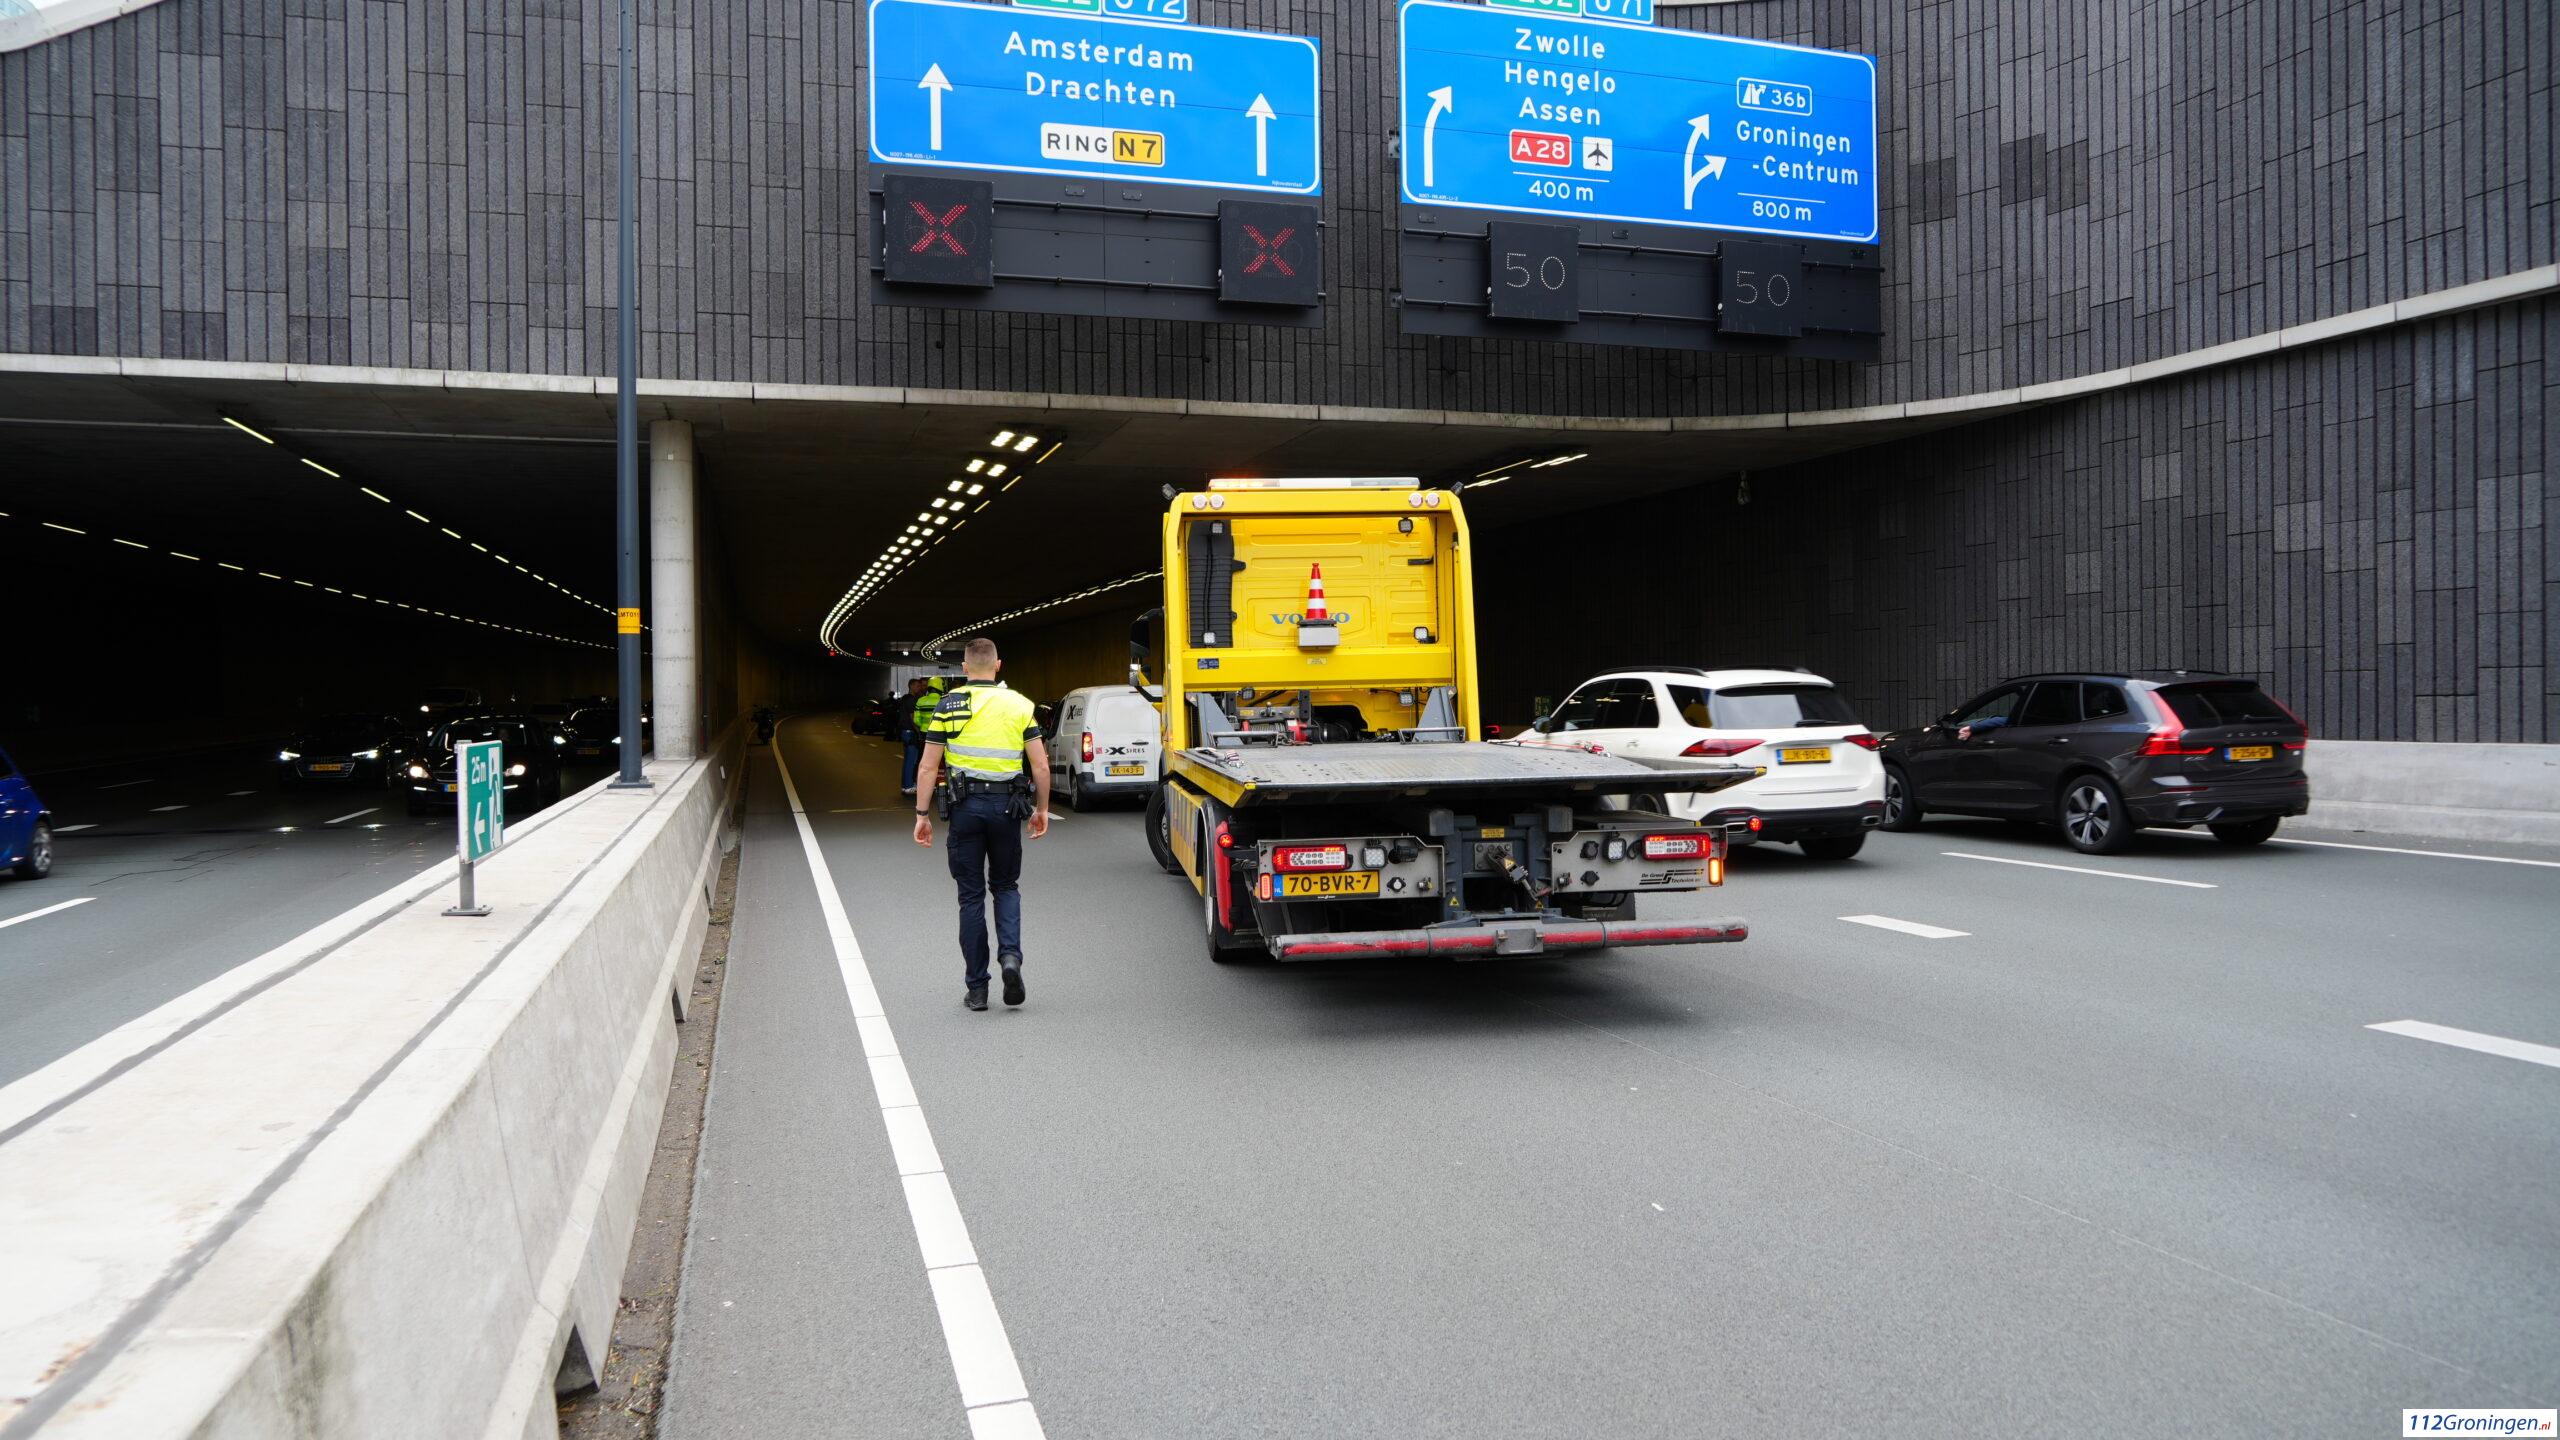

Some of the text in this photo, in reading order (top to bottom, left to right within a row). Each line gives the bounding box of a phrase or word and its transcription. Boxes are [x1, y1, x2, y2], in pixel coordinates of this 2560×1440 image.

[1005, 31, 1194, 72] Amsterdam
[1515, 27, 1605, 59] Zwolle
[1026, 71, 1176, 109] Drachten
[1505, 61, 1616, 96] Hengelo
[1519, 97, 1601, 126] Assen
[1771, 88, 1806, 109] 36b
[1047, 133, 1108, 153] RING
[1515, 138, 1566, 160] A28
[1736, 120, 1851, 155] Groningen
[1752, 156, 1859, 186] -Centrum
[1529, 180, 1594, 201] 400 m
[1752, 201, 1812, 221] 800 m
[1506, 252, 1566, 290] 50
[1736, 271, 1790, 306] 50
[1269, 611, 1351, 625] VOO
[1288, 874, 1372, 893] 70-BVR-7
